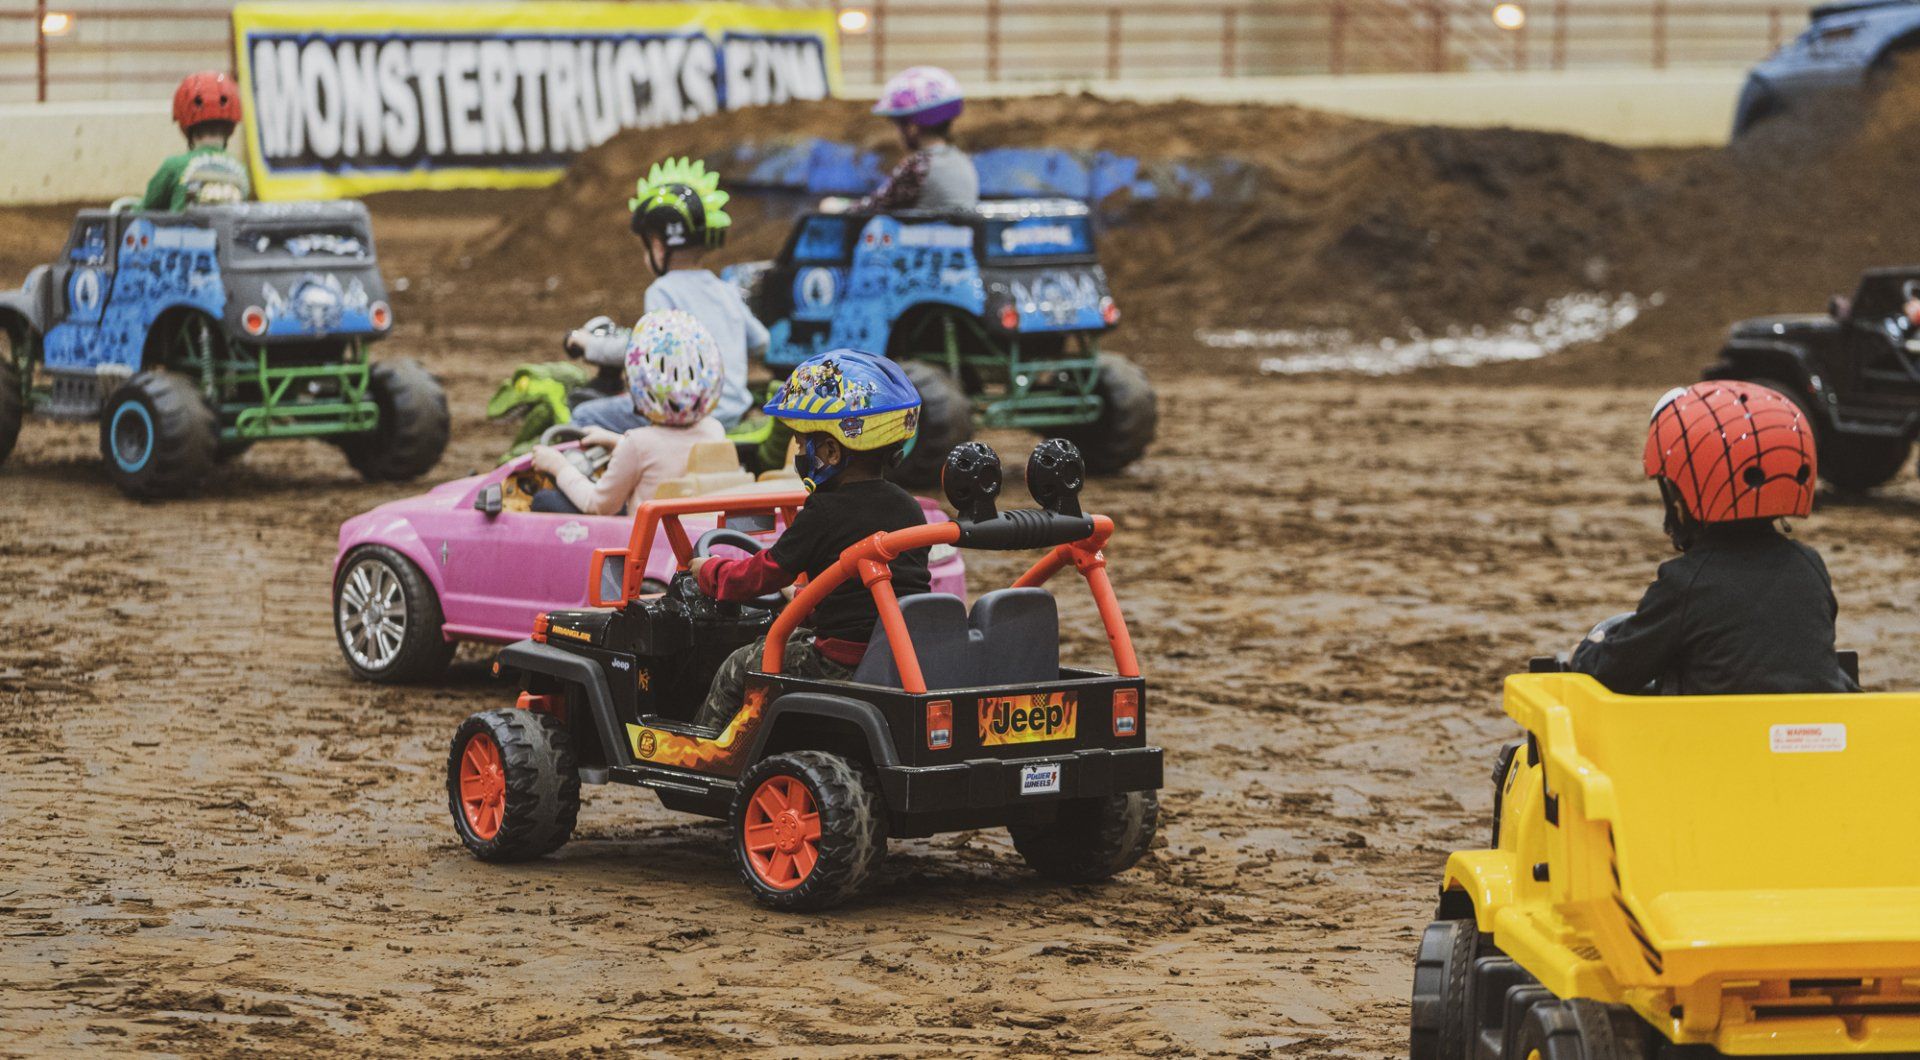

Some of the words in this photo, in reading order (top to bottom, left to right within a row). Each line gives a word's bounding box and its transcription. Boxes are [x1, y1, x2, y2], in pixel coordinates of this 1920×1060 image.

[552, 625, 592, 642] WRANGLER
[612, 658, 630, 671] Jeep
[992, 702, 1062, 735] Jeep
[1787, 728, 1822, 736] WARNING
[1026, 772, 1051, 780] POWER
[1024, 780, 1051, 788] WHEELS
